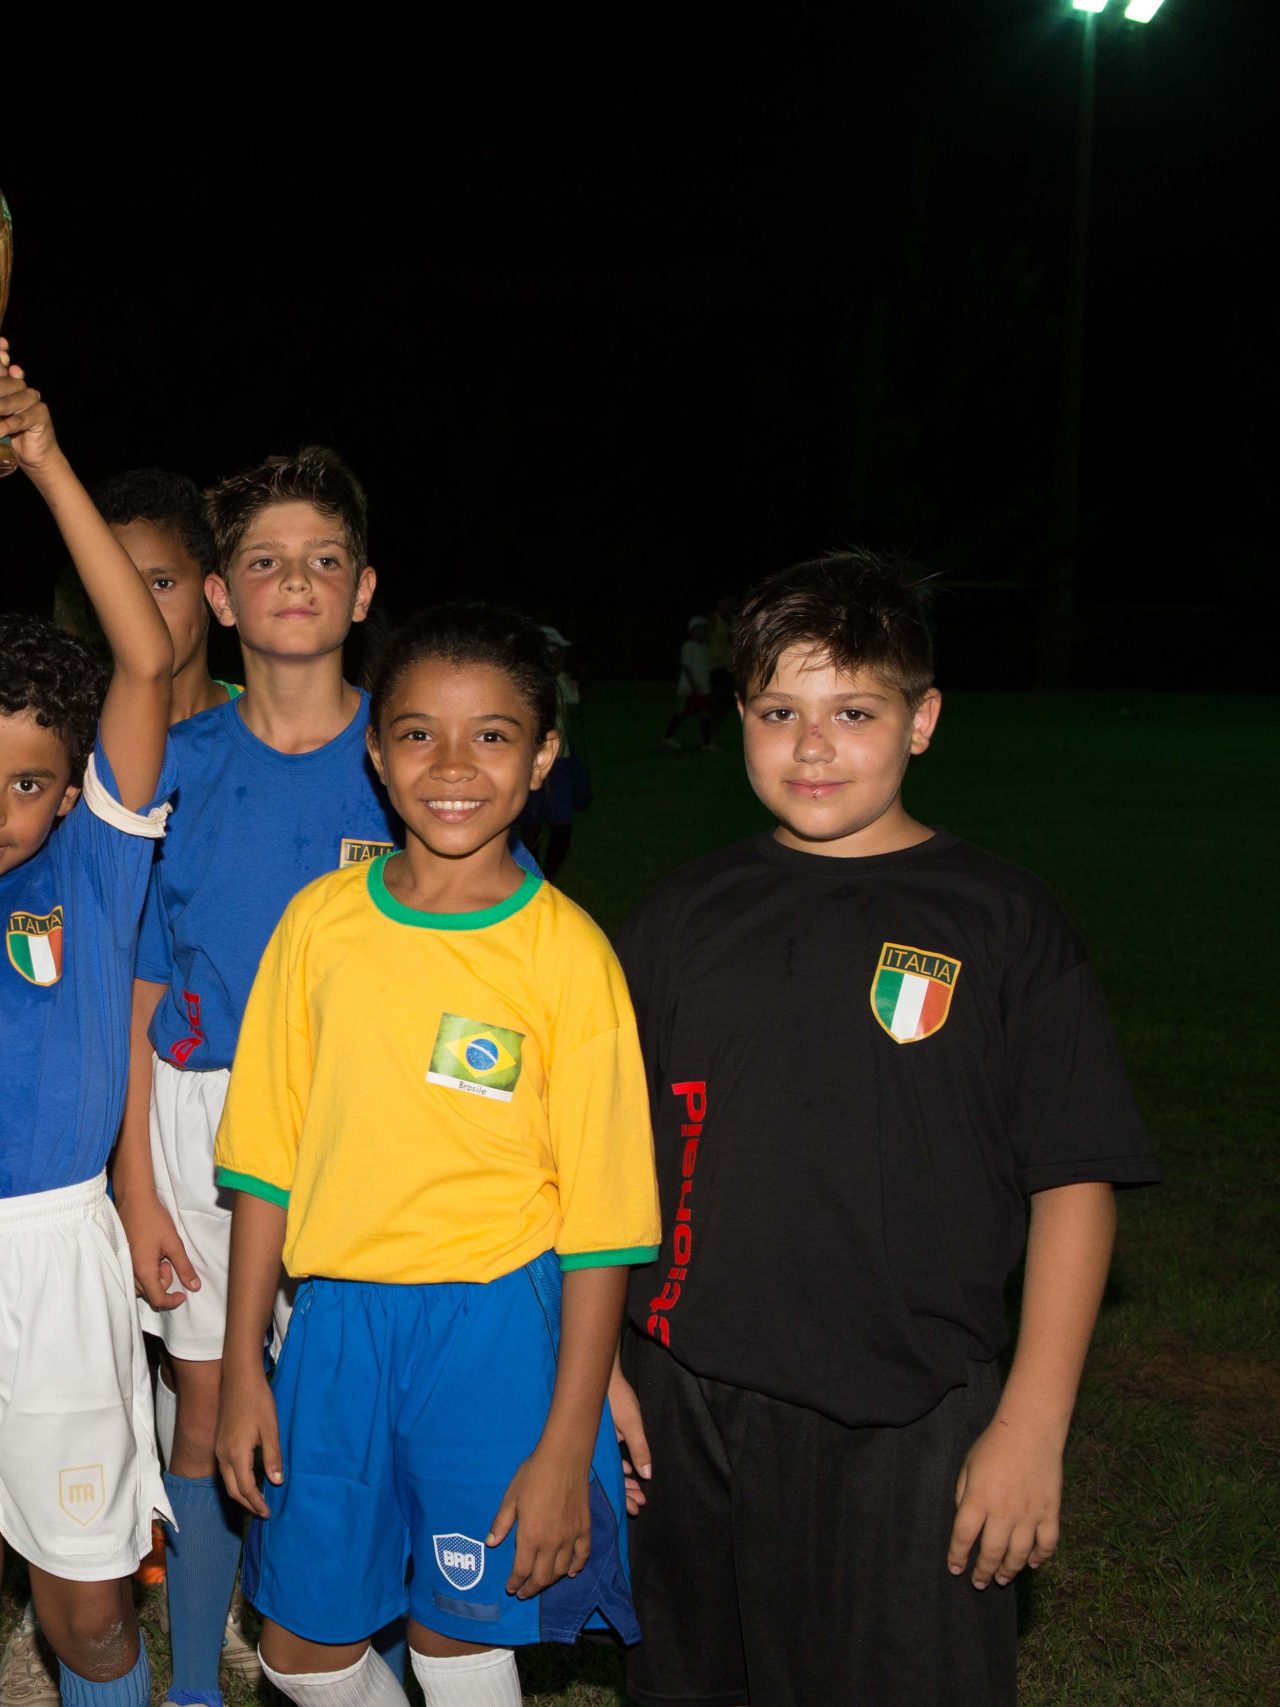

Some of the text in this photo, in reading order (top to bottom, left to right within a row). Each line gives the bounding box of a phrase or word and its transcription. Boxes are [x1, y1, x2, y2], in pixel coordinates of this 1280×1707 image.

[9, 913, 62, 935] ITALIA
[885, 948, 952, 983] ITALIA
[458, 1081, 488, 1096] Brasile
[68, 1483, 95, 1504] ITA
[443, 1550, 476, 1571] BRA
